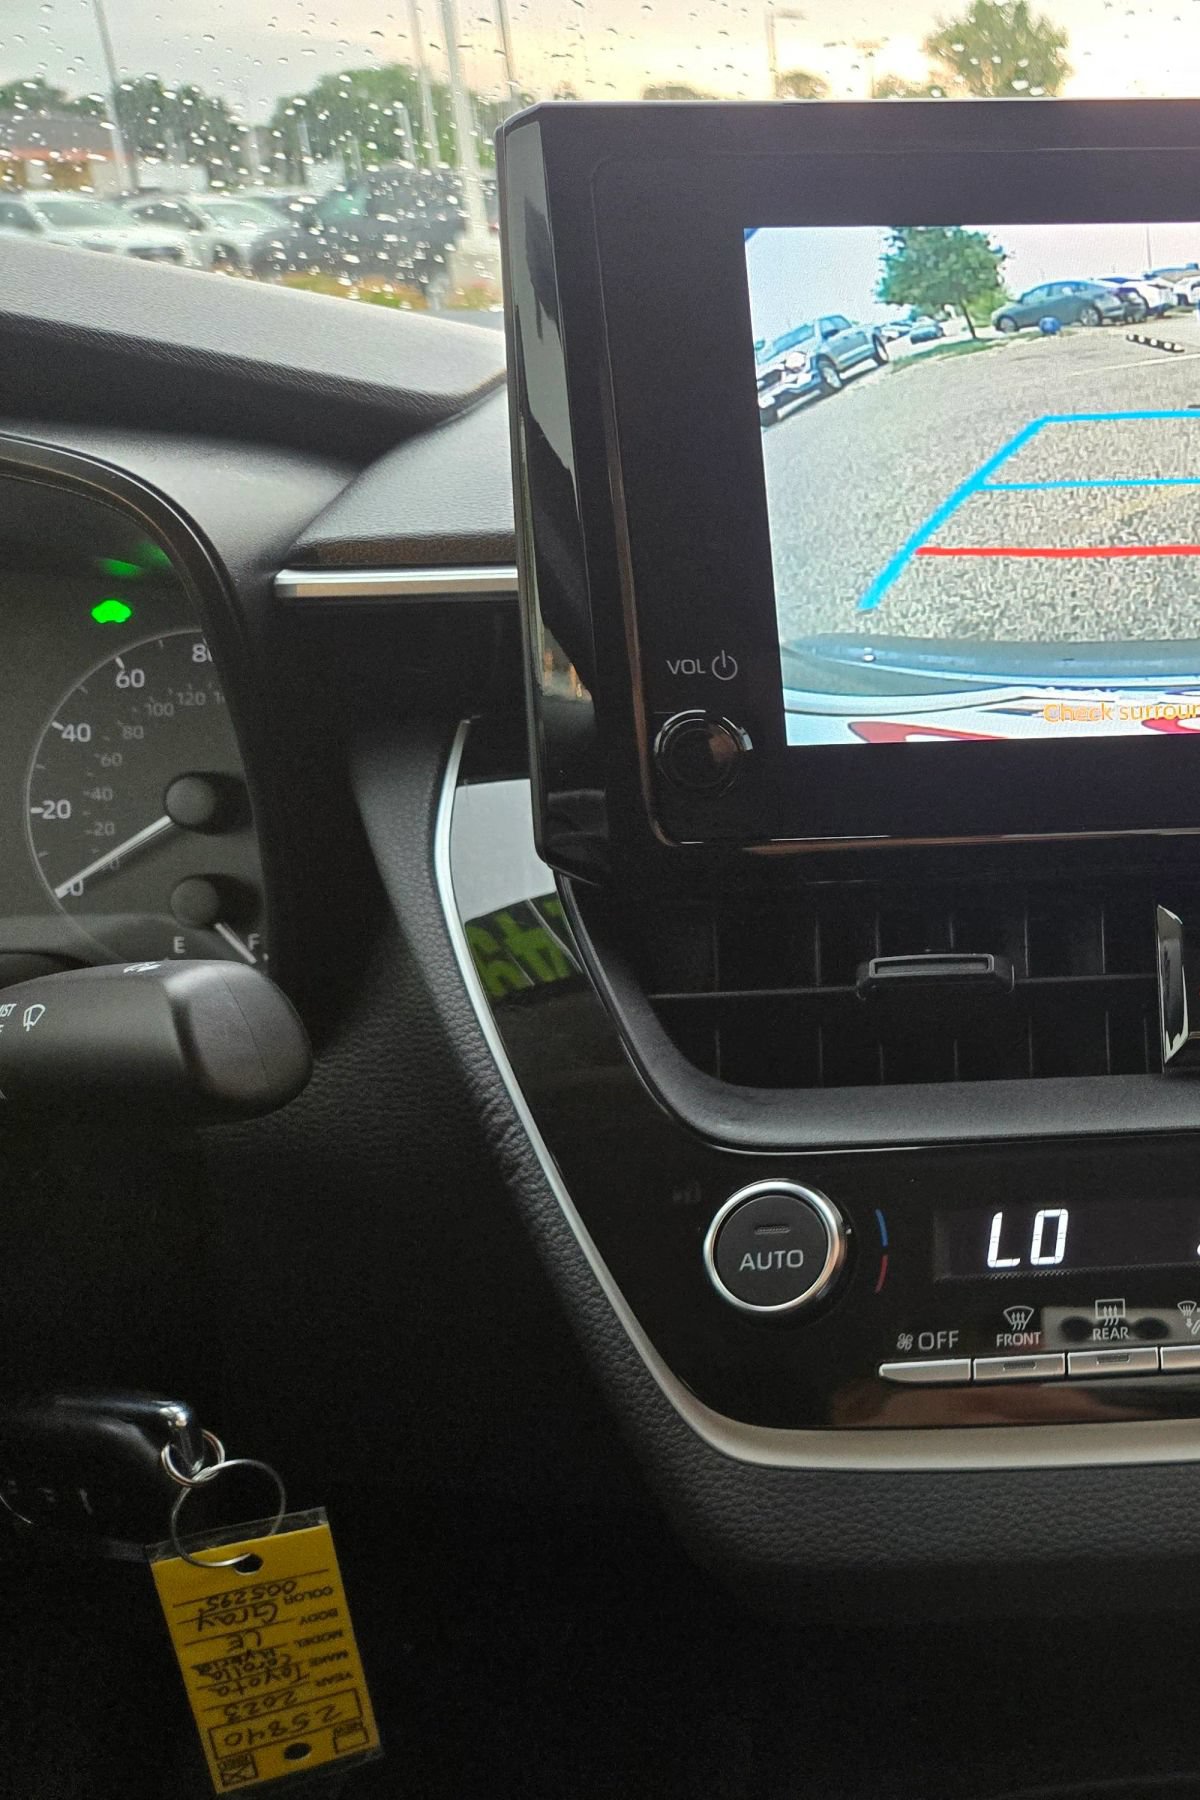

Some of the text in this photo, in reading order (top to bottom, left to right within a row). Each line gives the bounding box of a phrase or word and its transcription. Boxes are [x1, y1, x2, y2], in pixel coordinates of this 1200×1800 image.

[666, 659, 706, 675] VOL
[115, 668, 146, 688] 60
[177, 691, 206, 706] 120
[144, 702, 175, 717] 100
[1043, 702, 1116, 723] Check
[61, 722, 92, 742] 40
[122, 725, 144, 740] 80
[101, 752, 123, 767] 60
[92, 787, 113, 801] 40
[42, 799, 72, 820] 20
[94, 822, 115, 837] 20
[70, 879, 85, 897] 0
[173, 935, 186, 954] E
[247, 933, 260, 950] F
[986, 1208, 1069, 1268] LO
[738, 1249, 804, 1272] AUTO
[918, 1330, 959, 1351] OFF
[995, 1331, 1041, 1348] FRONT
[1092, 1325, 1130, 1341] REAR
[206, 1580, 298, 1611] 005295
[284, 1586, 334, 1605] COLOR
[197, 1602, 278, 1632] Gray
[298, 1607, 338, 1626] BODY
[226, 1630, 263, 1653] LE
[294, 1629, 344, 1648] MODEL
[309, 1649, 349, 1667] MAKE
[208, 1663, 310, 1697] Toyota
[316, 1671, 353, 1688] YEAR
[223, 1691, 298, 1723] 2023
[224, 1703, 342, 1747] 25840
